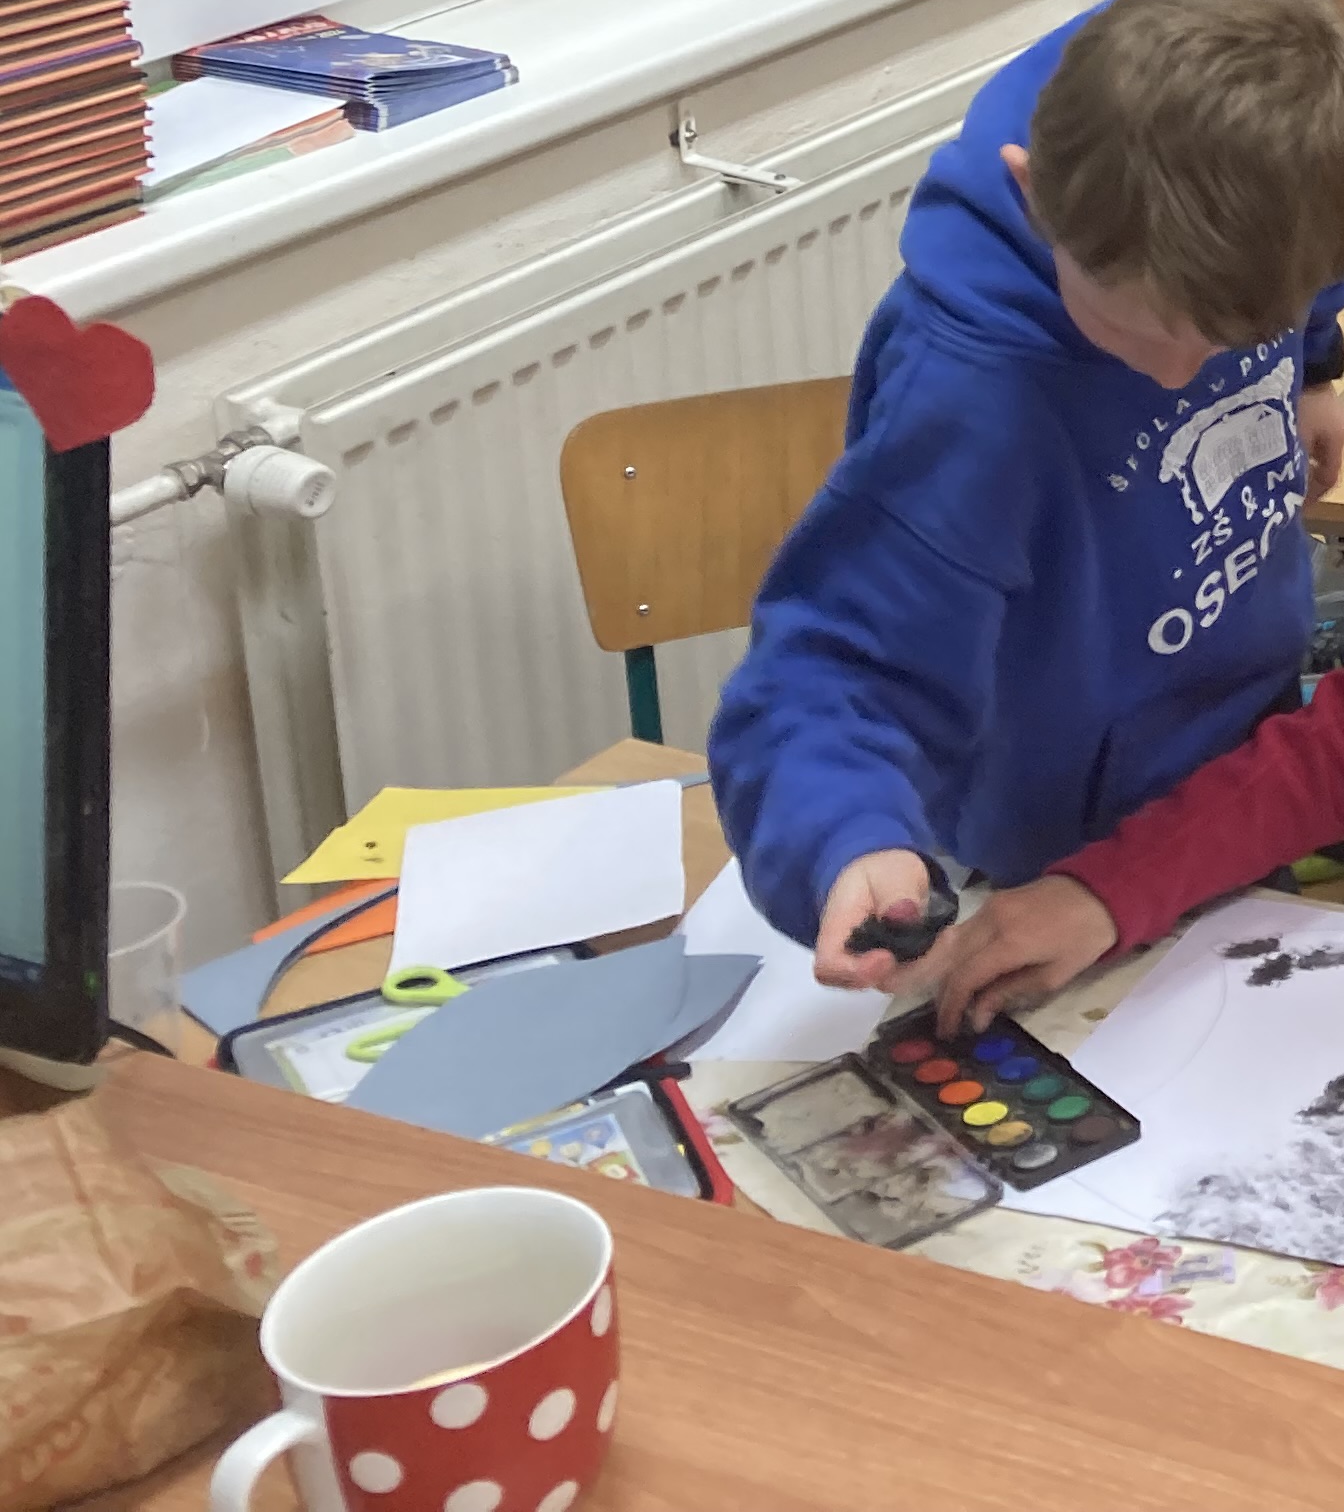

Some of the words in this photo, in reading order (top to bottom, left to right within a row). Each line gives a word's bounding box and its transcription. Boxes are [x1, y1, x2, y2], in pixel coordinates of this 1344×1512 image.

[1107, 398, 1191, 492] ŠKOLA
[1191, 507, 1233, 566] ZŠ
[1241, 486, 1258, 520] &
